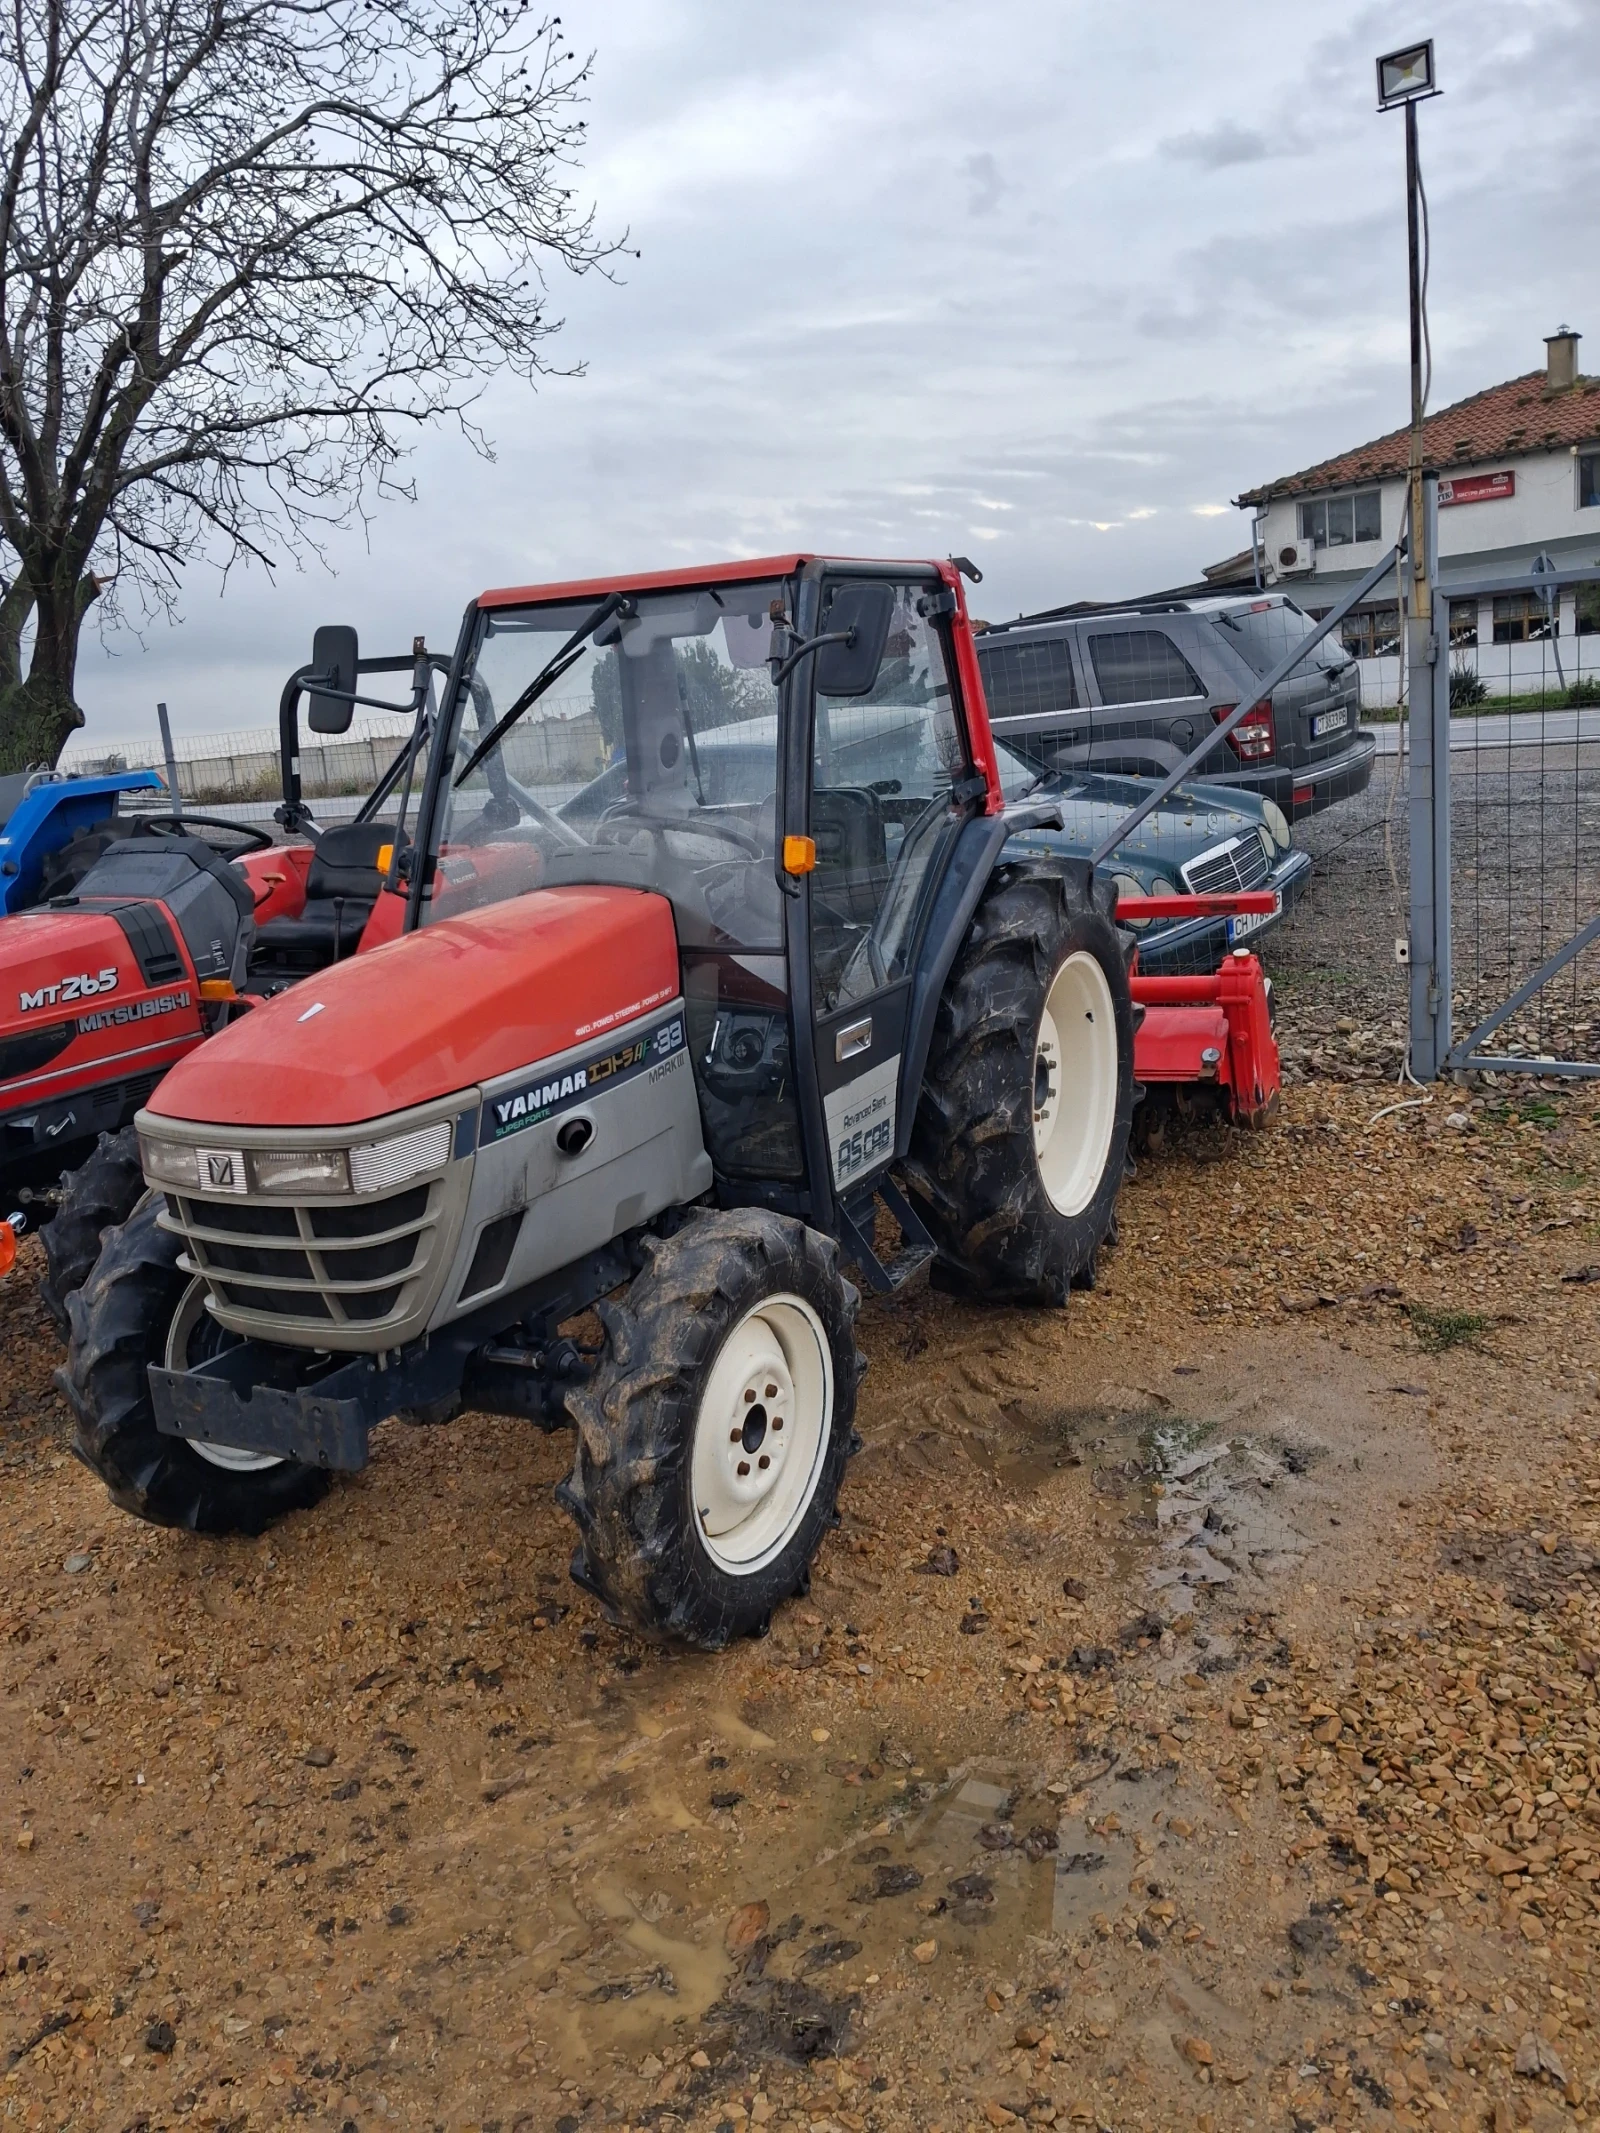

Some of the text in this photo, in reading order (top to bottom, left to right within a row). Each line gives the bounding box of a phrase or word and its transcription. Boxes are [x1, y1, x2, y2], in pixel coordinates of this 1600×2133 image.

[20, 967, 119, 1012] MT265
[78, 991, 191, 1034] MITSUBISHI
[497, 1069, 587, 1123] YANMAR
[843, 1095, 887, 1130] Advanced Silent
[495, 1107, 551, 1137] SUPER FORTE
